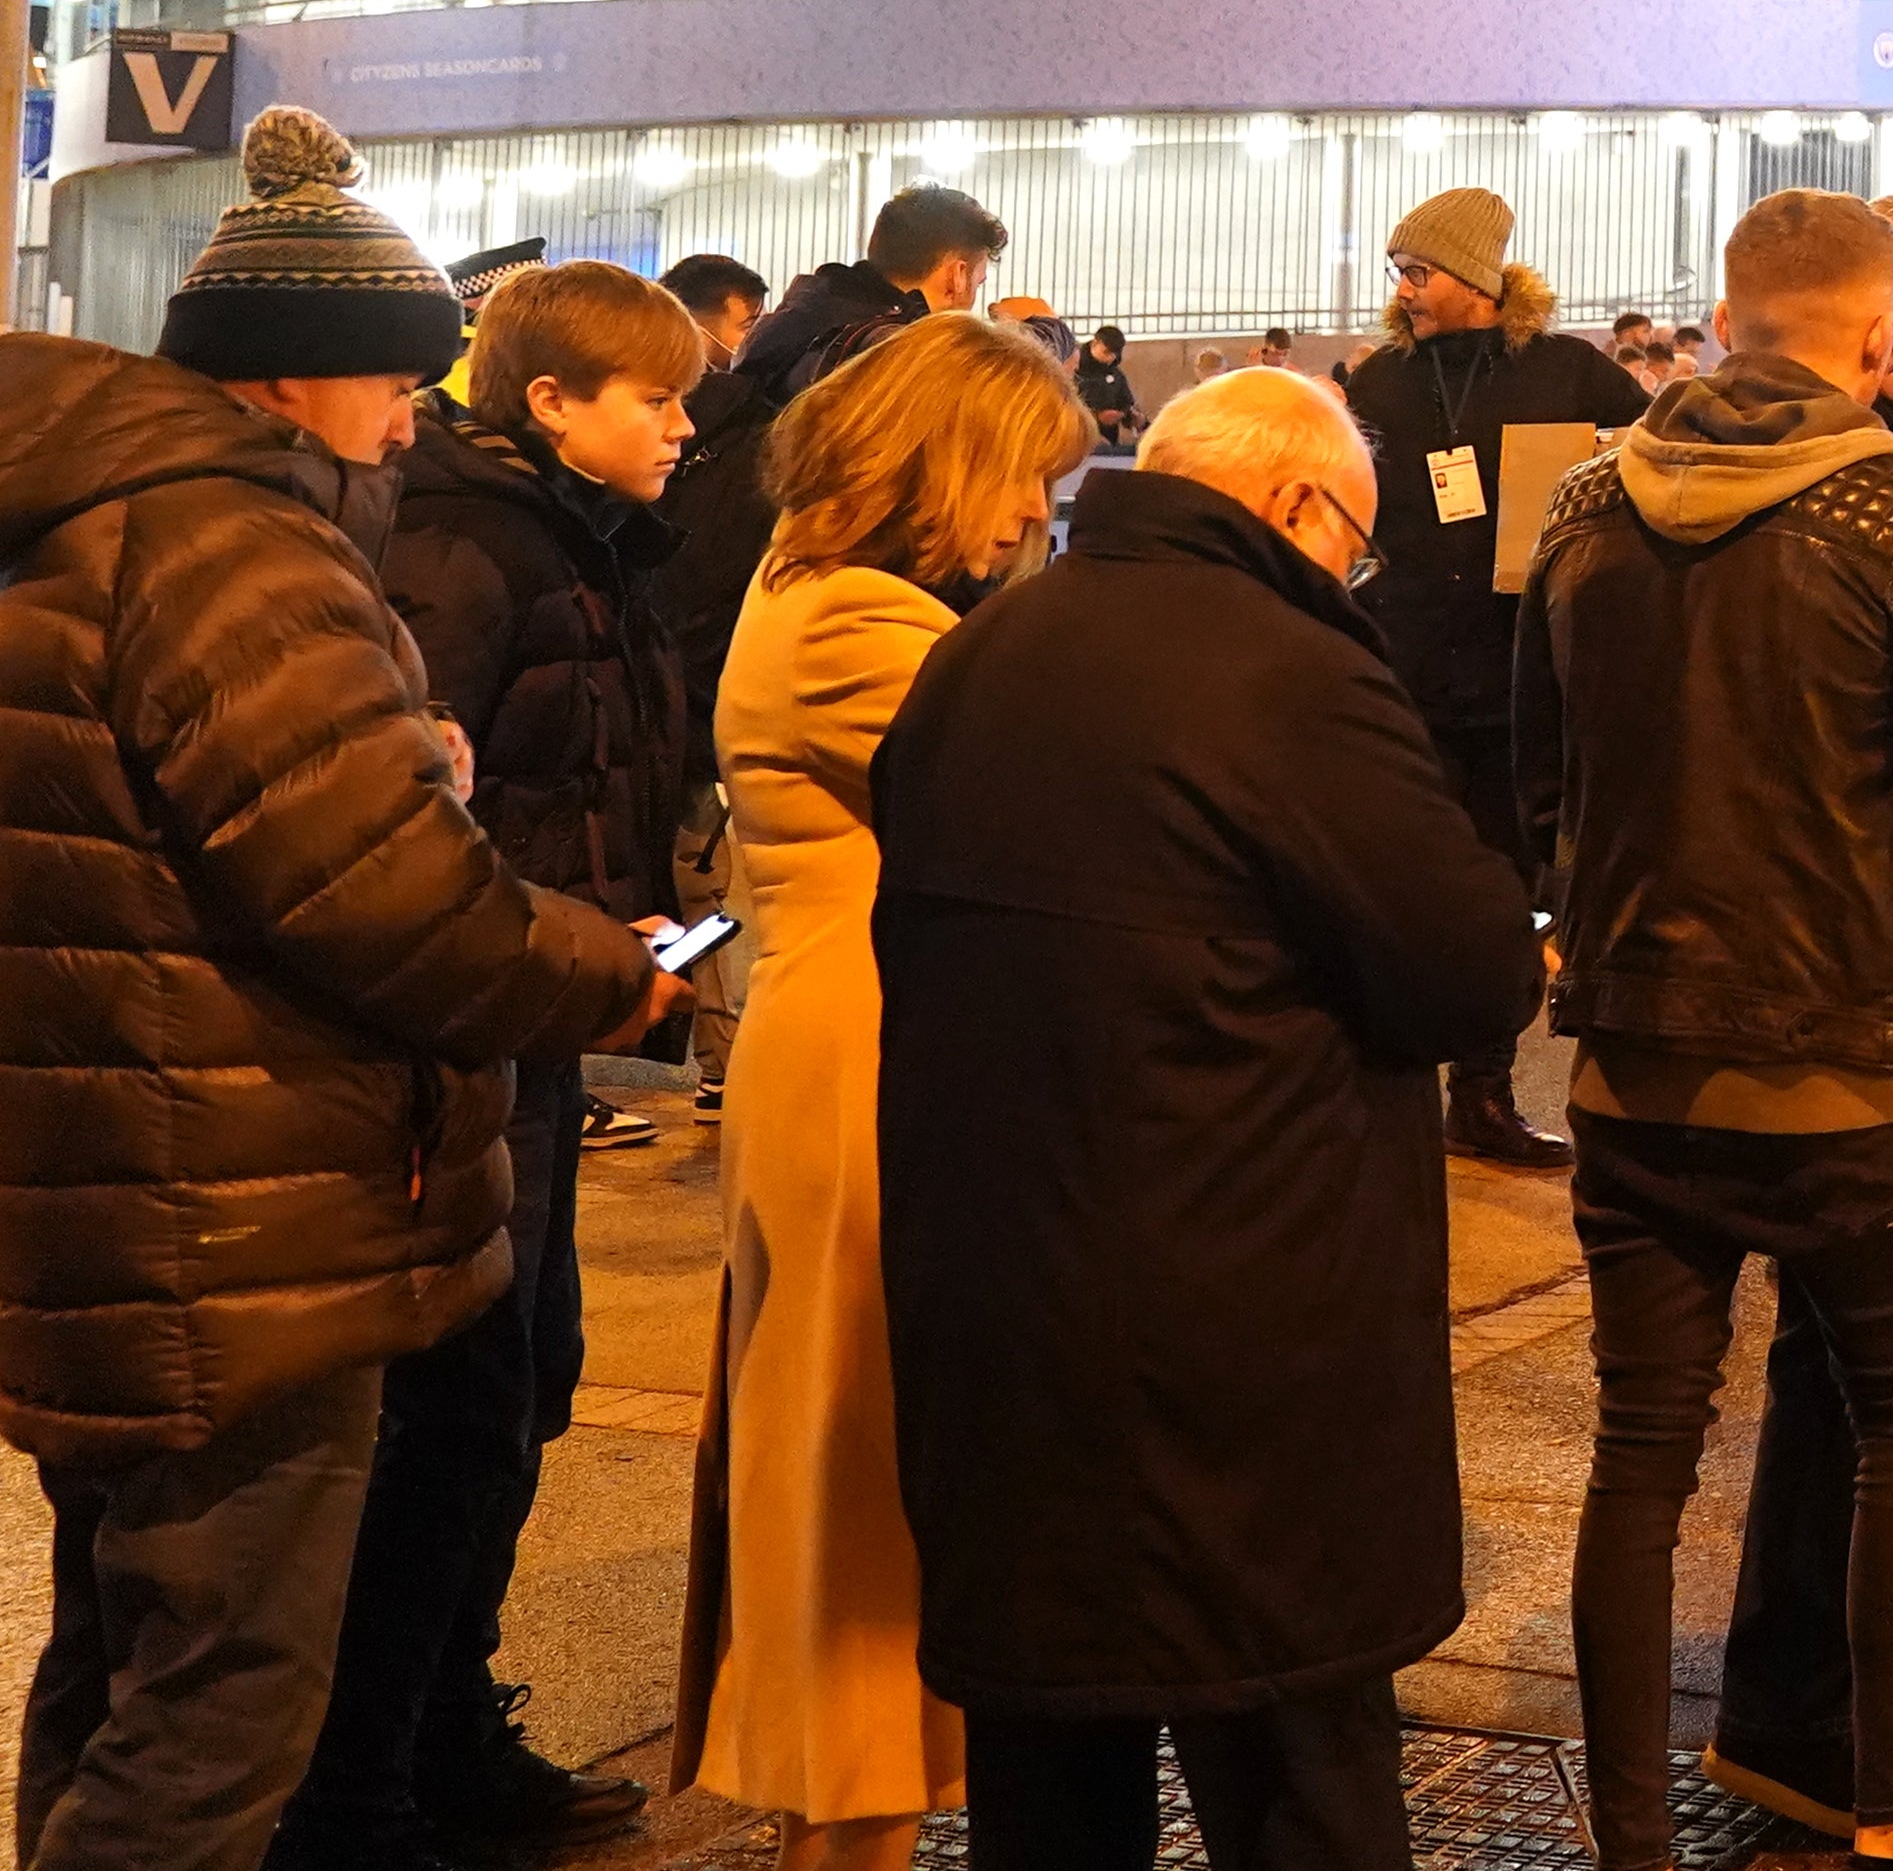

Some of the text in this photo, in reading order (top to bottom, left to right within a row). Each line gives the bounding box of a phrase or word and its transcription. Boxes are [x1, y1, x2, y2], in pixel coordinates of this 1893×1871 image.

[123, 50, 219, 134] V
[349, 54, 543, 82] CITYZENS SEASONCARDS
